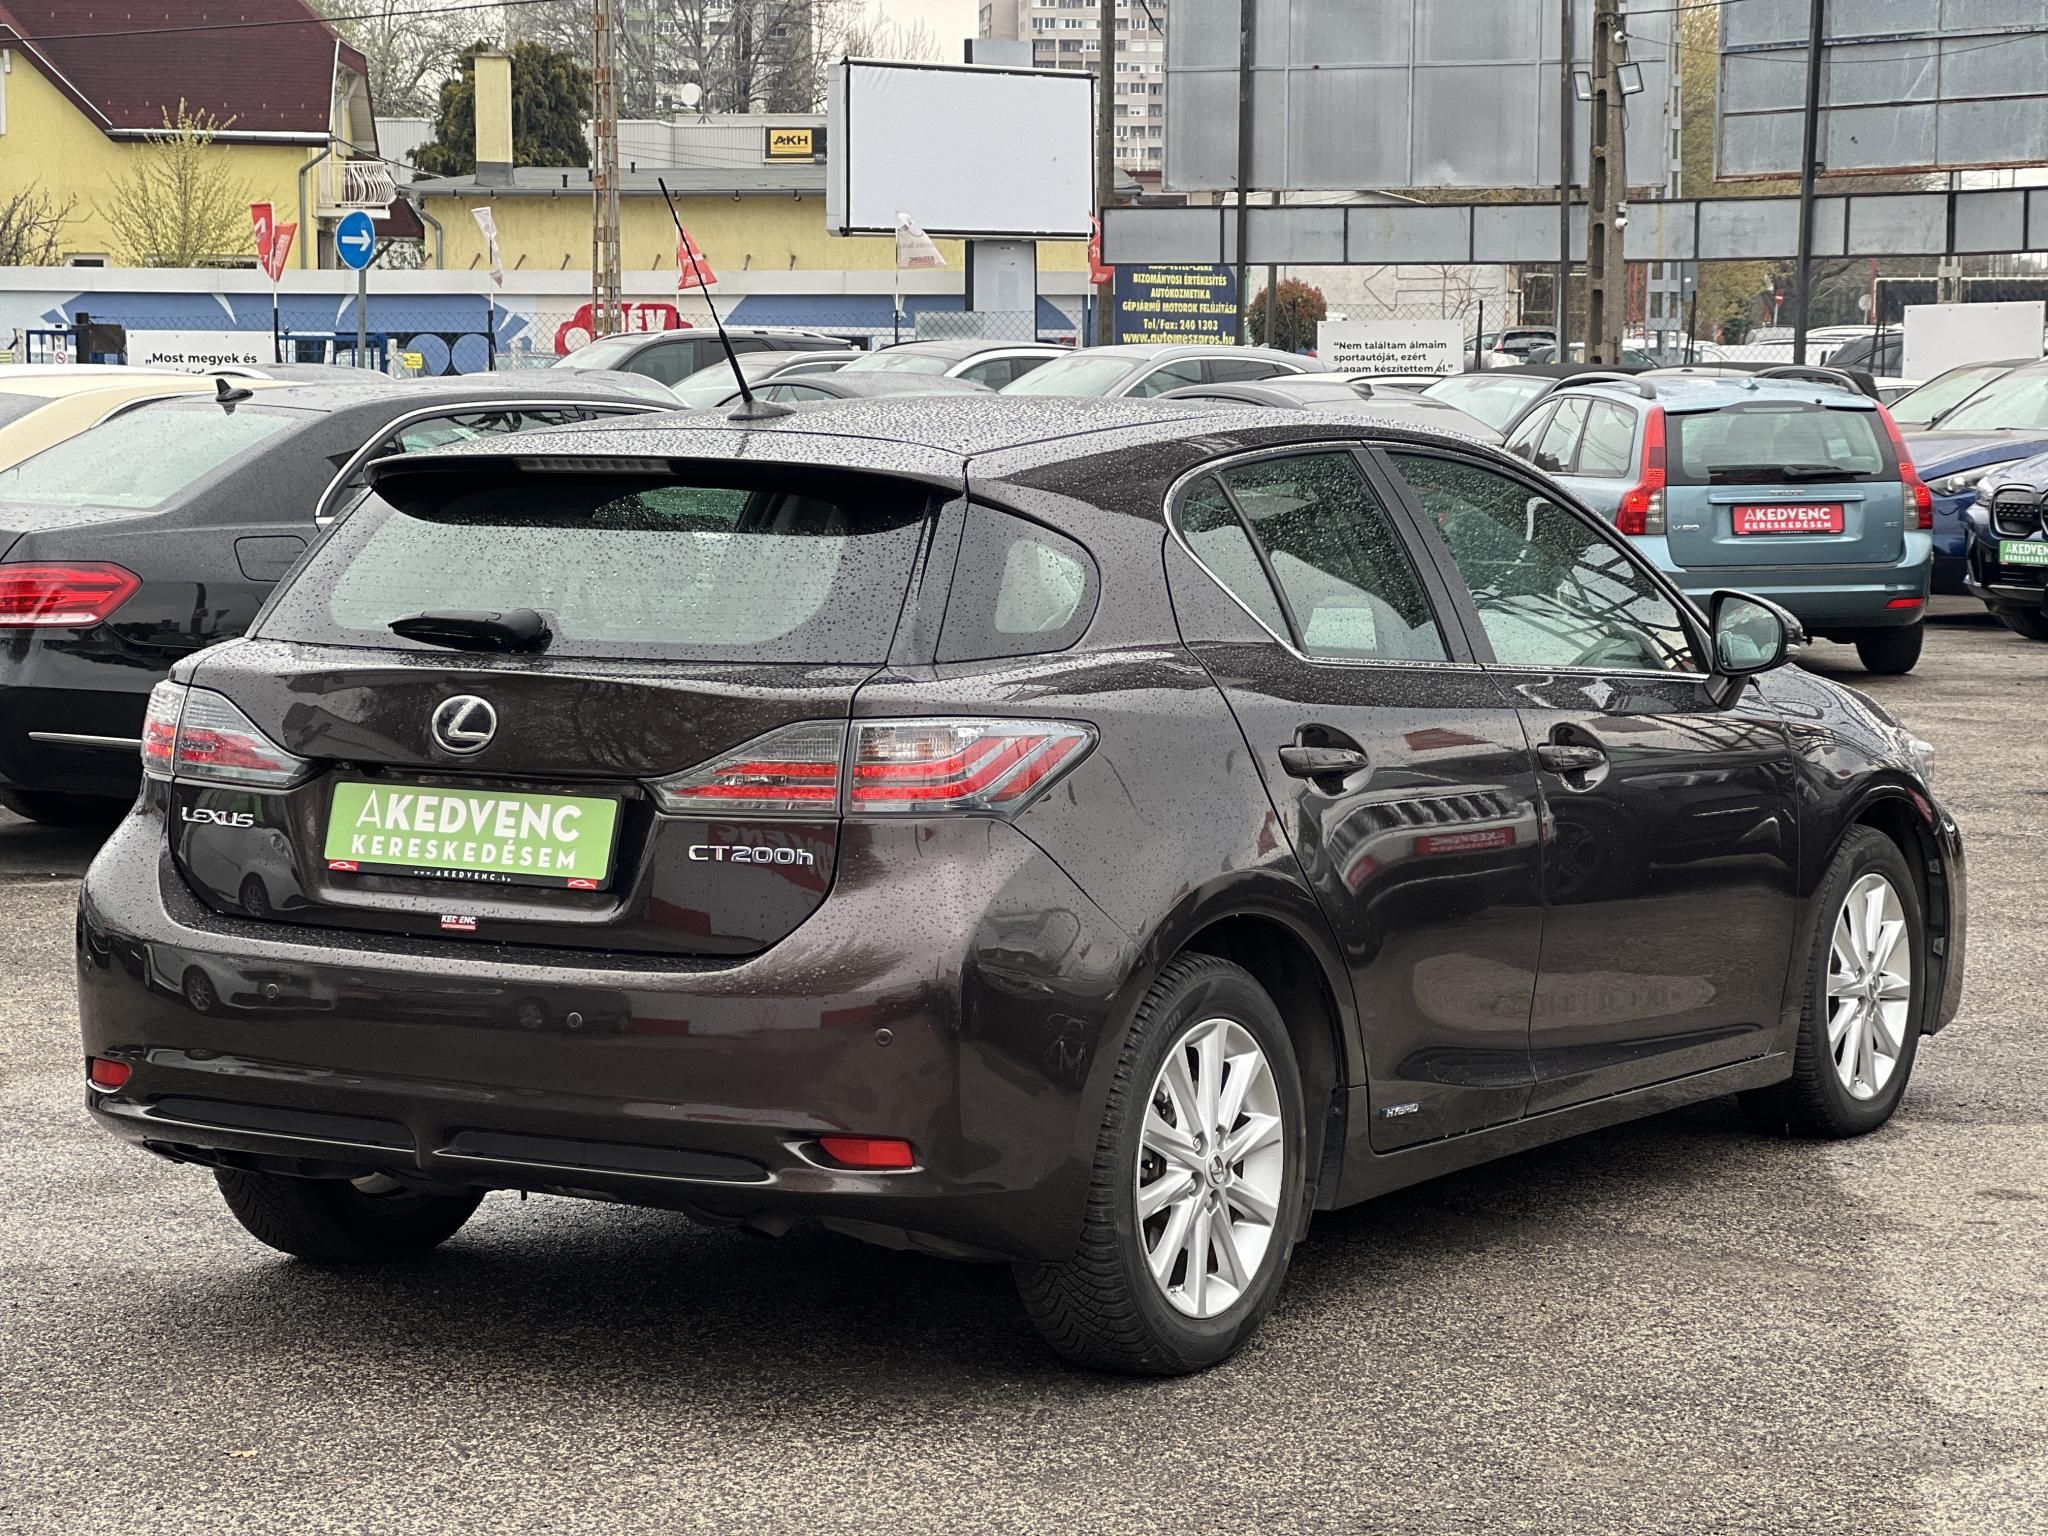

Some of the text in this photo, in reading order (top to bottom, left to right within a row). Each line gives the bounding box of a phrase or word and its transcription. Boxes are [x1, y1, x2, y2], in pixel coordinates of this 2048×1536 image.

[1133, 272, 1182, 285] BIZOMÁNYOSI
[1150, 287, 1211, 299] AUTÓKOZMETIKA
[1162, 302, 1198, 313] MOTOROK
[1143, 319, 1218, 331] Tel/Fax: 240 1303
[1365, 340, 1407, 350] találtam
[1409, 340, 1447, 349] álmaim
[188, 353, 239, 366] megyek
[243, 353, 258, 364] és
[1333, 353, 1427, 363] sportautóját, ezért
[1374, 364, 1434, 373] készítettem
[1745, 508, 1831, 520] AKEDVENC
[1744, 519, 1832, 529] KERESKEDÉSEM
[181, 806, 254, 828] LEXUS
[356, 789, 582, 842] AKEDVENC
[351, 833, 576, 870] KERESKEDÉSEM
[688, 845, 814, 865] CT200h
